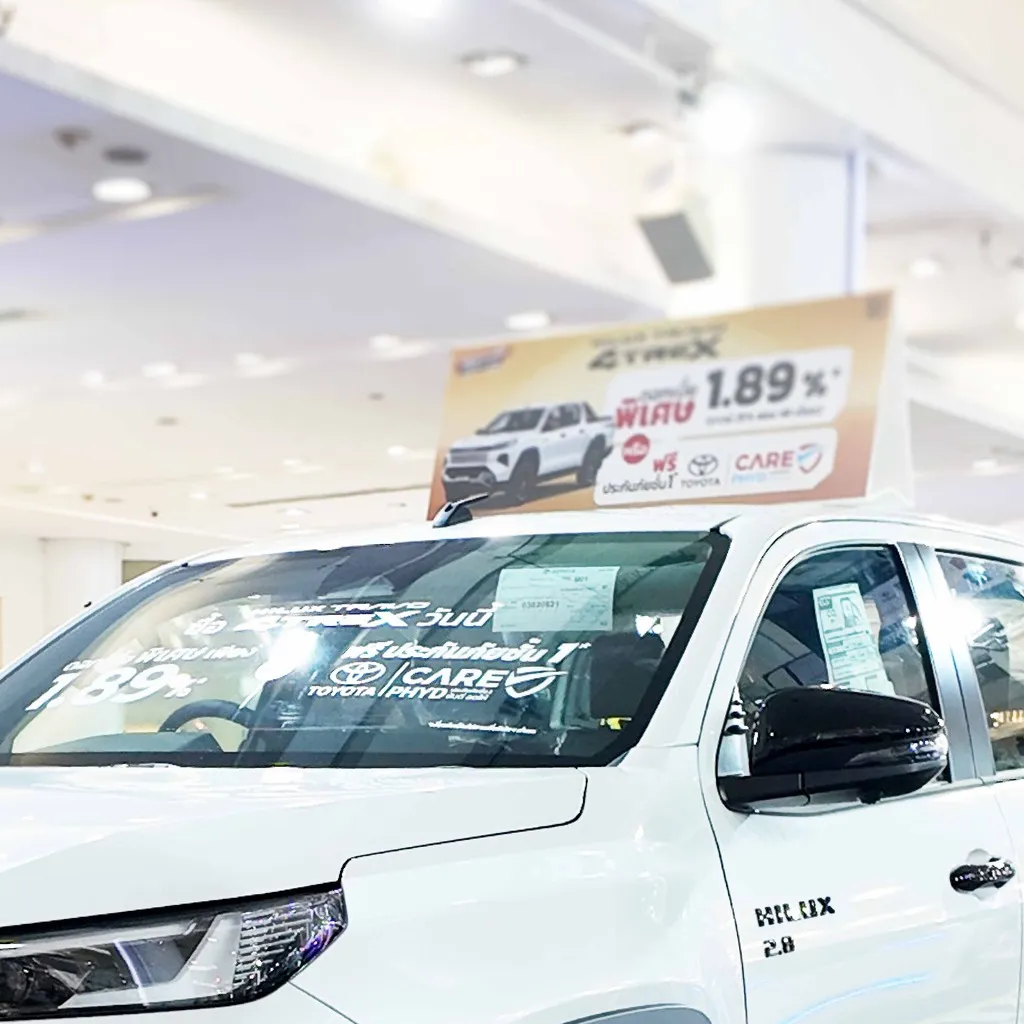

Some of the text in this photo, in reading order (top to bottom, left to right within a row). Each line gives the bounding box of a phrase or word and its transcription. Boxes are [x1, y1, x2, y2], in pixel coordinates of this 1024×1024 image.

[615, 396, 696, 430] พิเศษ
[735, 451, 795, 472] CARE
[681, 478, 721, 489] TOYOTA
[403, 667, 510, 688] CARE
[307, 685, 376, 697] TOYOTA
[385, 687, 448, 699] PHYD
[754, 896, 835, 927] HILUX
[763, 935, 795, 958] 2.8
